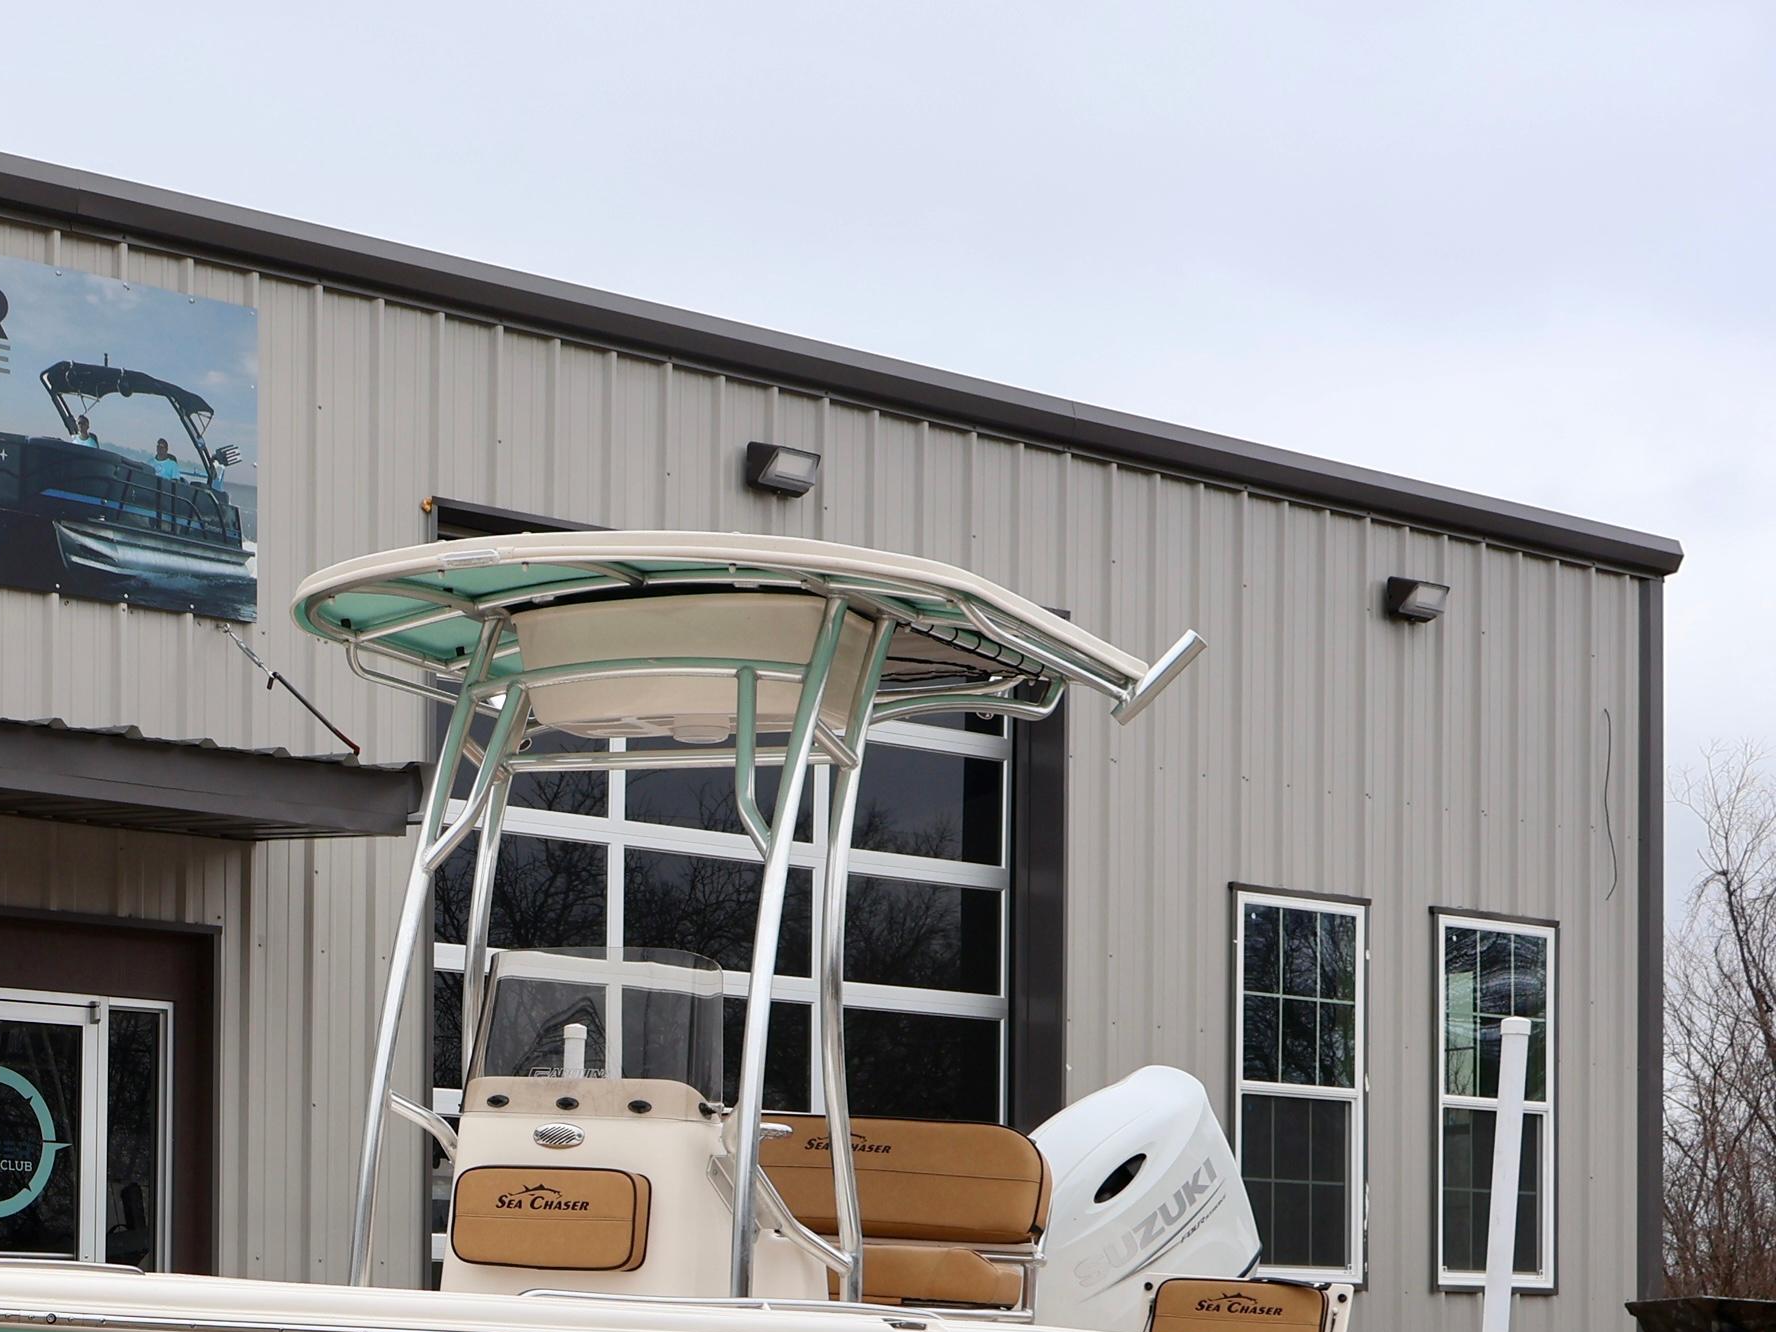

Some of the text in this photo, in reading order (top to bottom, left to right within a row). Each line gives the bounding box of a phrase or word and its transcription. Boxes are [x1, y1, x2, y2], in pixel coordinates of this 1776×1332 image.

[0, 1159, 33, 1172] CLUB
[495, 1194, 590, 1211] SEA CHASER
[1073, 1157, 1218, 1288] SUZUKI
[1194, 1299, 1284, 1316] SEA CHASER
